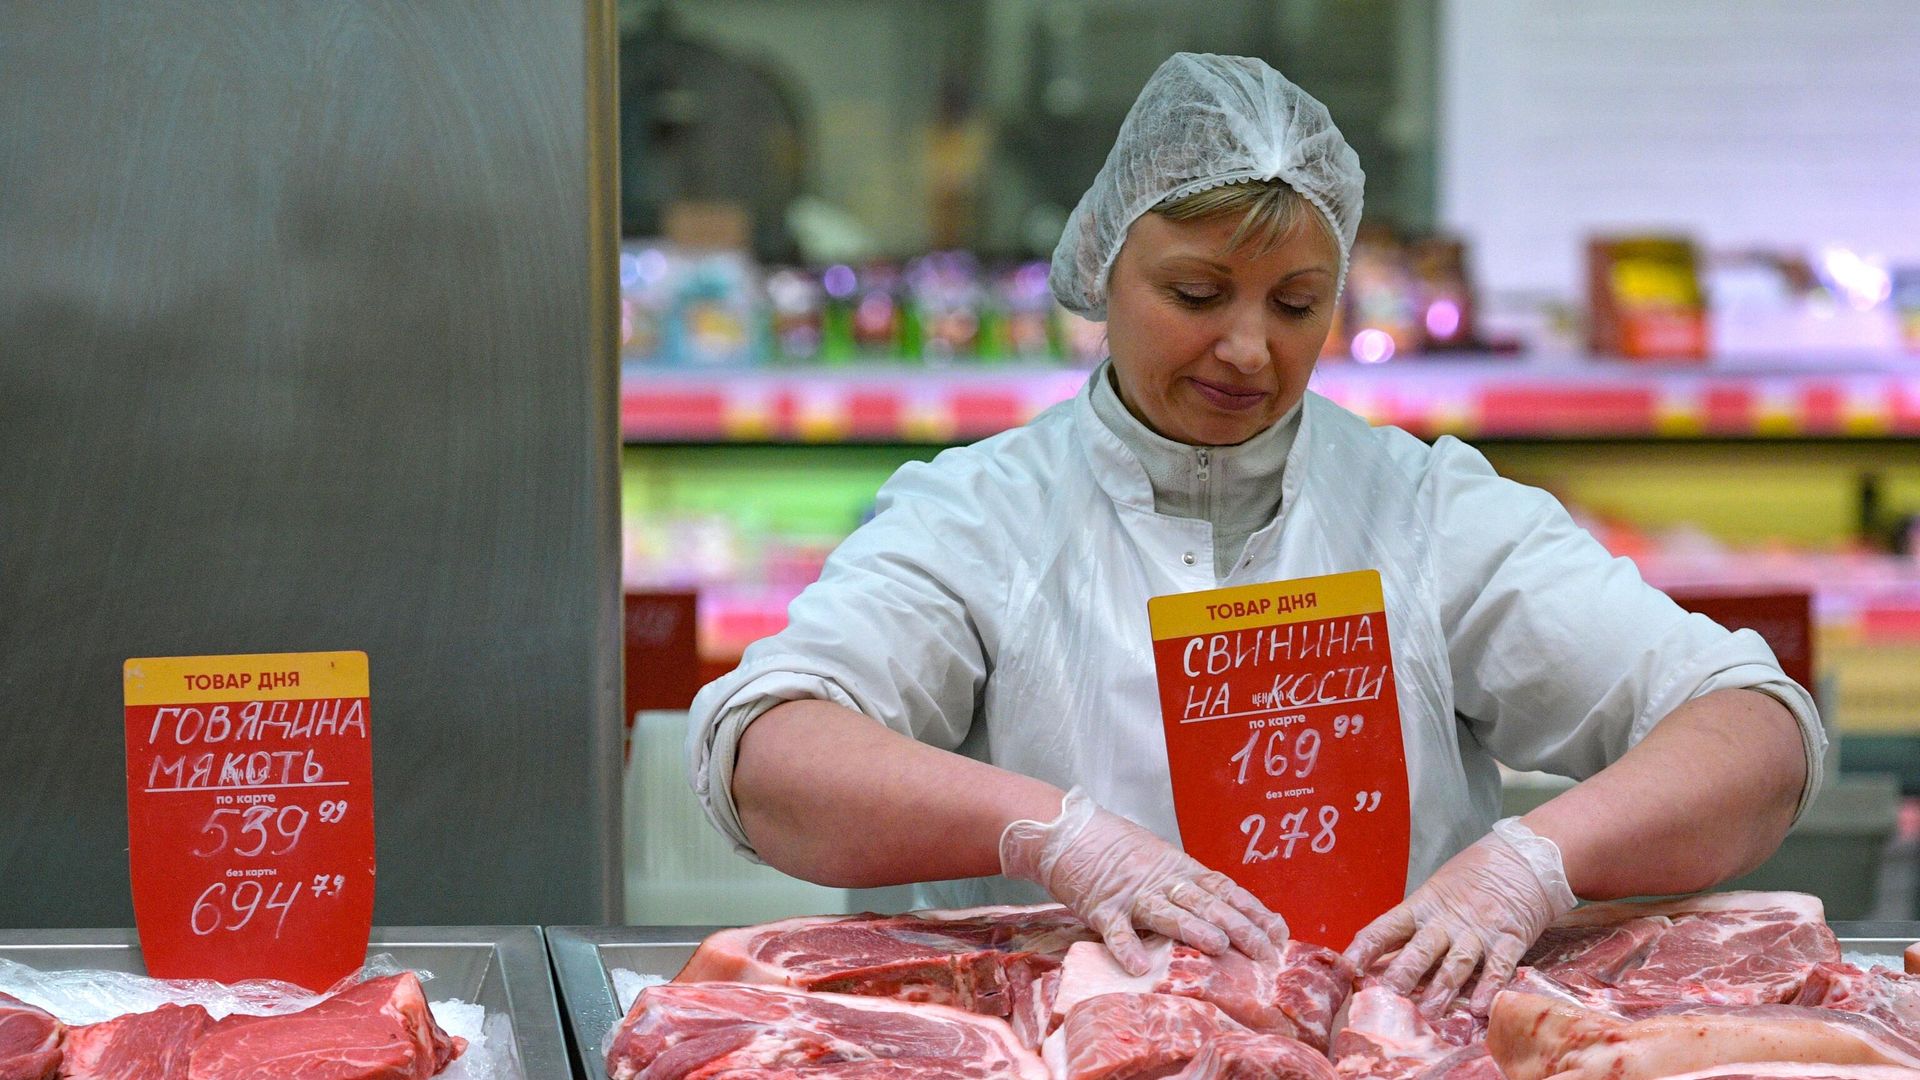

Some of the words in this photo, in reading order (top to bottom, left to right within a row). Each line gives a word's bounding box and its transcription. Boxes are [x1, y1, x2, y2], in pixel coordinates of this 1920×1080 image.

[1206, 599, 1271, 620] ТОВАР
[1277, 592, 1317, 614] ДНЯ
[1183, 614, 1374, 678] СВИНИНА
[184, 673, 251, 691] ТОВАР
[257, 671, 300, 690] ДНЯ
[1183, 682, 1231, 719] НА
[1266, 665, 1388, 711] КОСТИ
[148, 698, 367, 745] ГОВЯДИНА
[1249, 719, 1265, 729] по
[1268, 713, 1306, 727] карте
[148, 749, 324, 789] МЯКОТЬ
[1230, 728, 1322, 785] 169
[216, 795, 233, 805] по
[236, 793, 277, 805] карте
[1265, 790, 1282, 800] без
[1284, 786, 1315, 799] карты
[192, 805, 310, 857] 539
[318, 799, 348, 824] 99
[1239, 805, 1340, 865] 278
[226, 867, 243, 878] без
[245, 867, 277, 877] карты
[190, 880, 303, 939] 694
